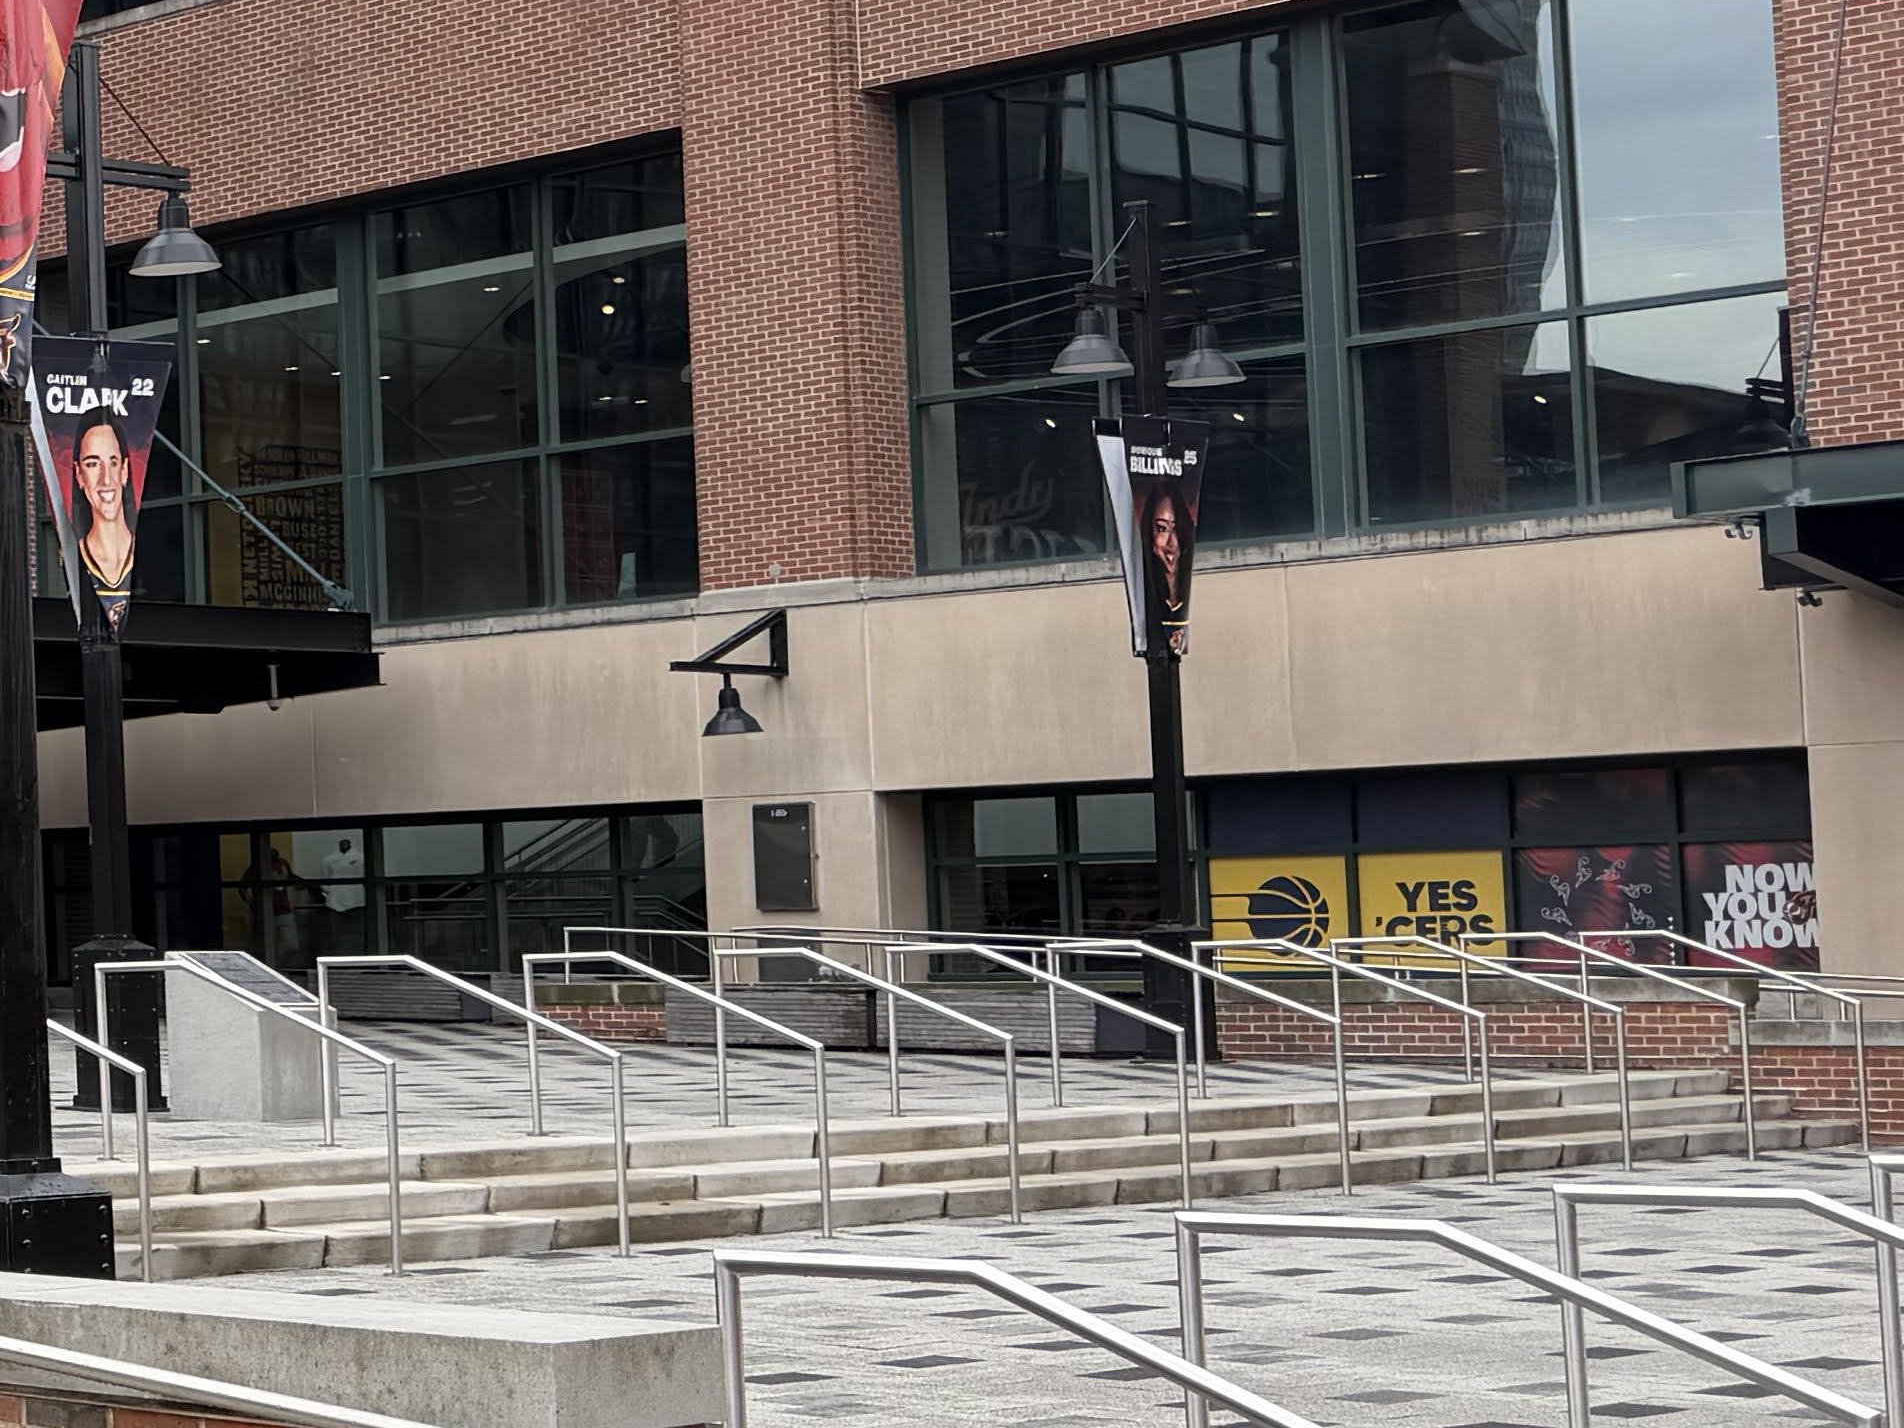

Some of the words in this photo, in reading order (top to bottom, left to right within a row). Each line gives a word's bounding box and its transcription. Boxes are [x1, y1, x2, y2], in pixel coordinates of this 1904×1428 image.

[46, 373, 88, 386] CAITLIN
[45, 386, 129, 416] CLARK
[131, 377, 154, 396] 22
[1724, 861, 1814, 893] NOW
[1395, 879, 1478, 913] YES
[1702, 891, 1787, 922] YOU
[1376, 914, 1495, 947] 'CERS
[1704, 917, 1821, 950] KNOW
